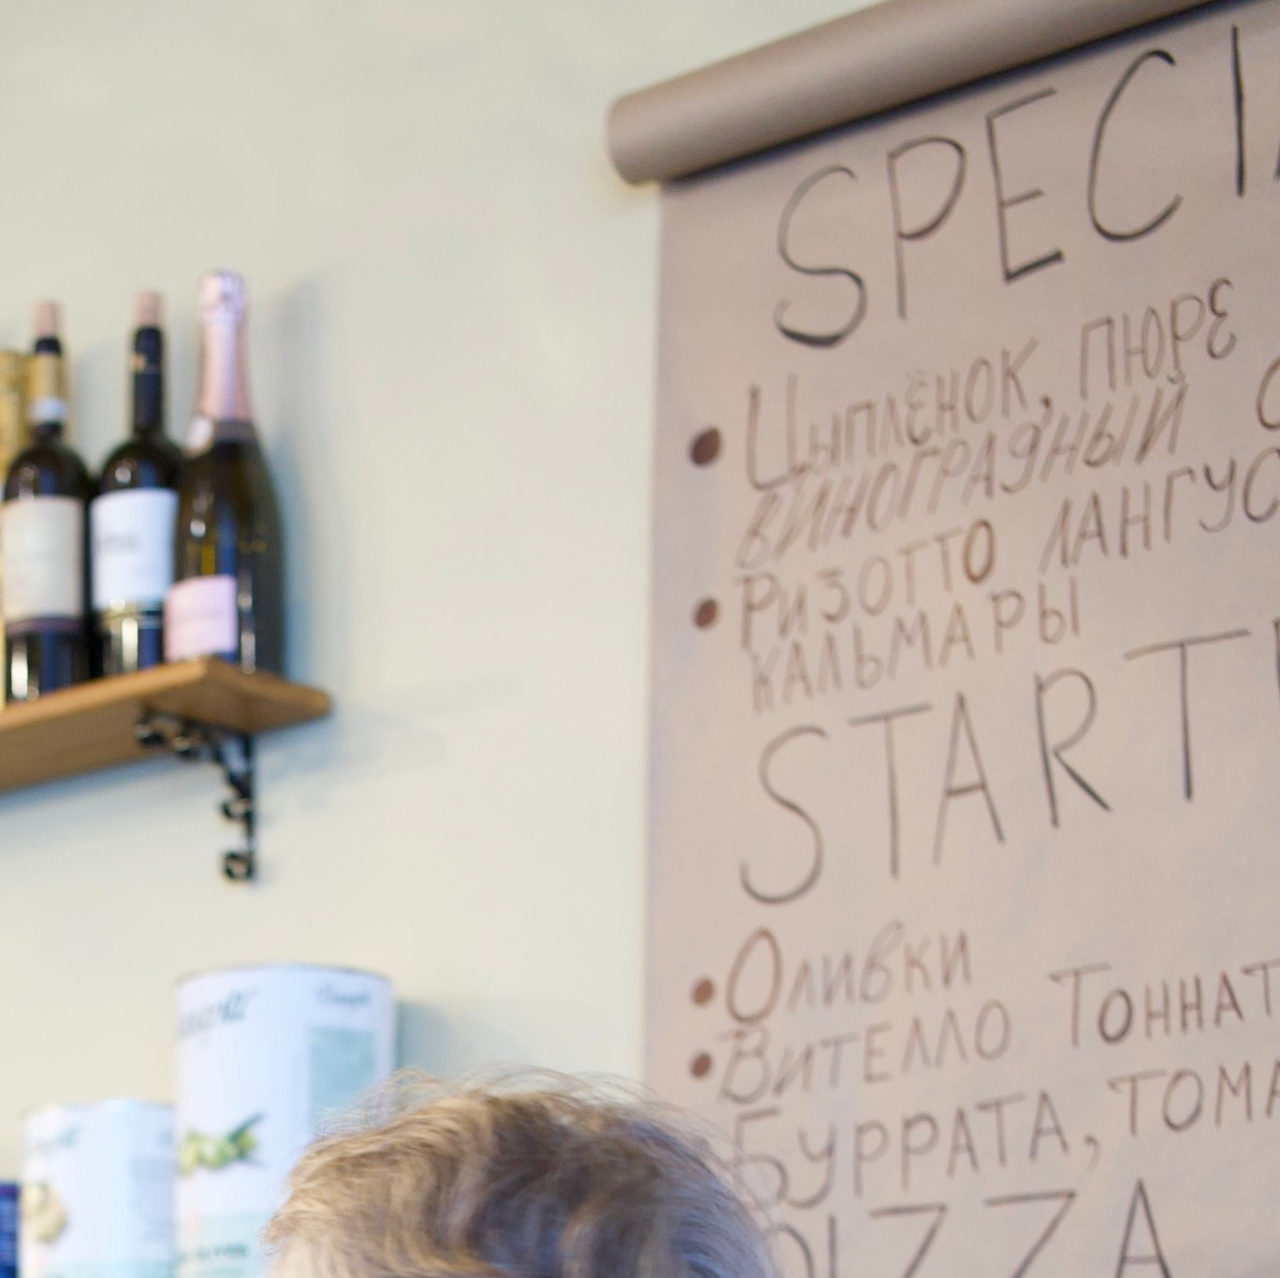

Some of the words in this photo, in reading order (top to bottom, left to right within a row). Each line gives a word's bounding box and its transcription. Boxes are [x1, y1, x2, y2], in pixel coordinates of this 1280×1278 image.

[774, 24, 1280, 348] SPECI
[732, 517, 996, 651] РИЗОТТО
[750, 574, 1081, 715] КАЛЬМАРЫ
[739, 616, 1280, 906] START
